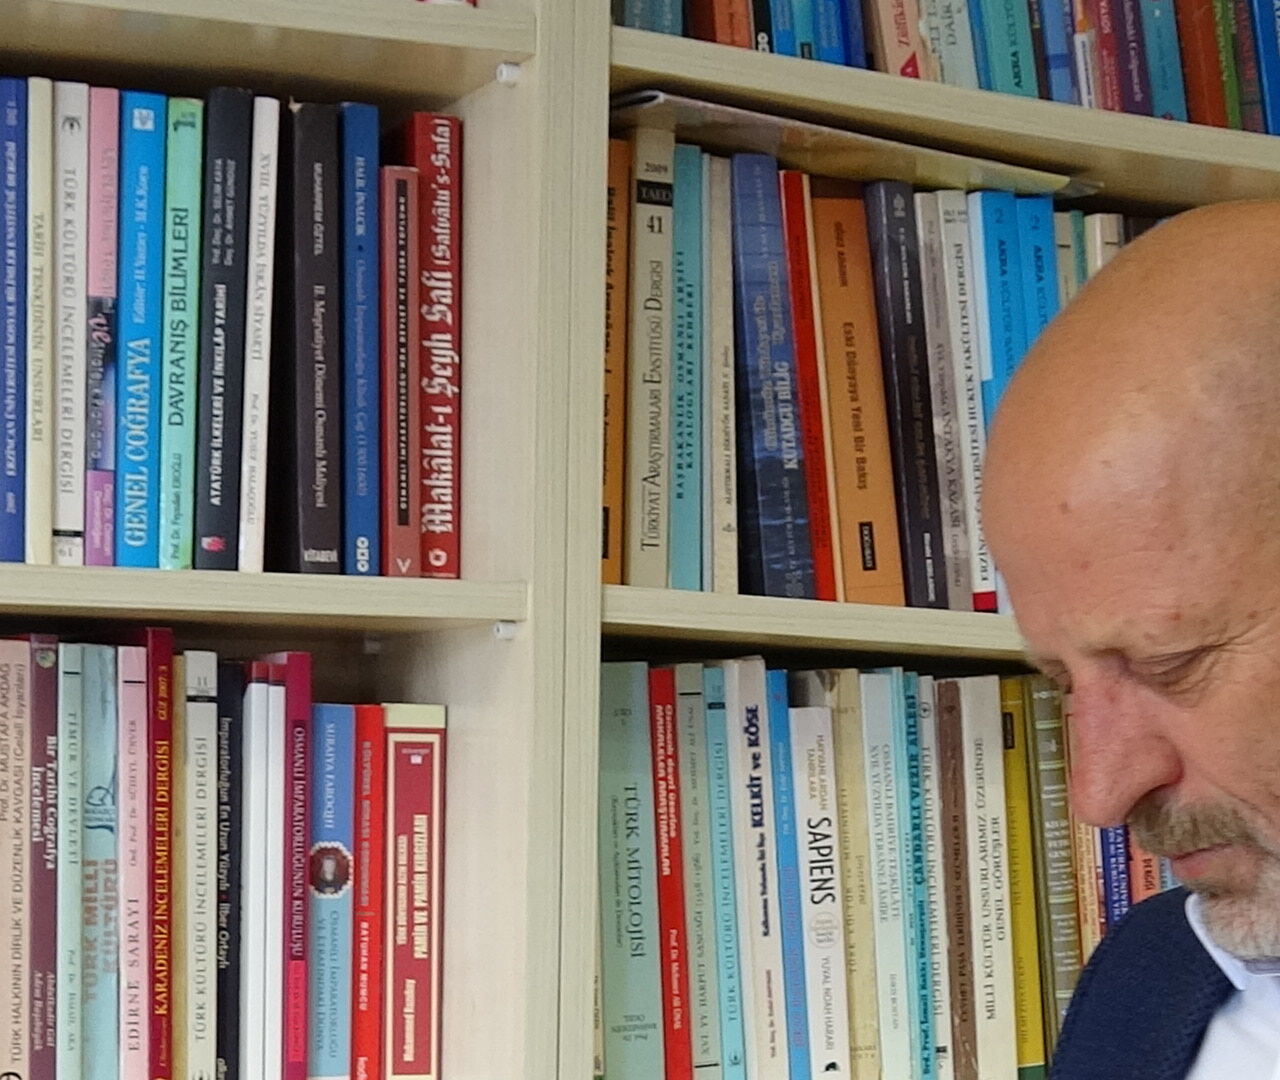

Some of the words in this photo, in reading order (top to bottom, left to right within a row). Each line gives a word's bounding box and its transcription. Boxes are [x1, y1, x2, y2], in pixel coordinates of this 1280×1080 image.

[168, 206, 189, 312] BİLİMLERİ
[124, 337, 152, 461] COĞRAFYA
[168, 319, 189, 427] DAVRANIŞ
[123, 467, 149, 548] GENEL
[154, 740, 170, 802] DERGİSİ
[192, 737, 208, 800] DERGİSİ
[218, 806, 230, 818] En
[622, 782, 646, 842] TÜRK
[154, 806, 170, 920] İNCELEMELERİ
[192, 804, 209, 916] İNCELEMELERİ
[806, 816, 835, 905] SAPIENS
[11, 899, 22, 913] VE
[625, 847, 648, 959] MİTOLOJİSİ
[154, 924, 170, 1015] KARADENİZ
[192, 921, 208, 995] KÜLTÜRÜ
[10, 1028, 23, 1063] TÜRK
[193, 1002, 208, 1043] TÜRK
